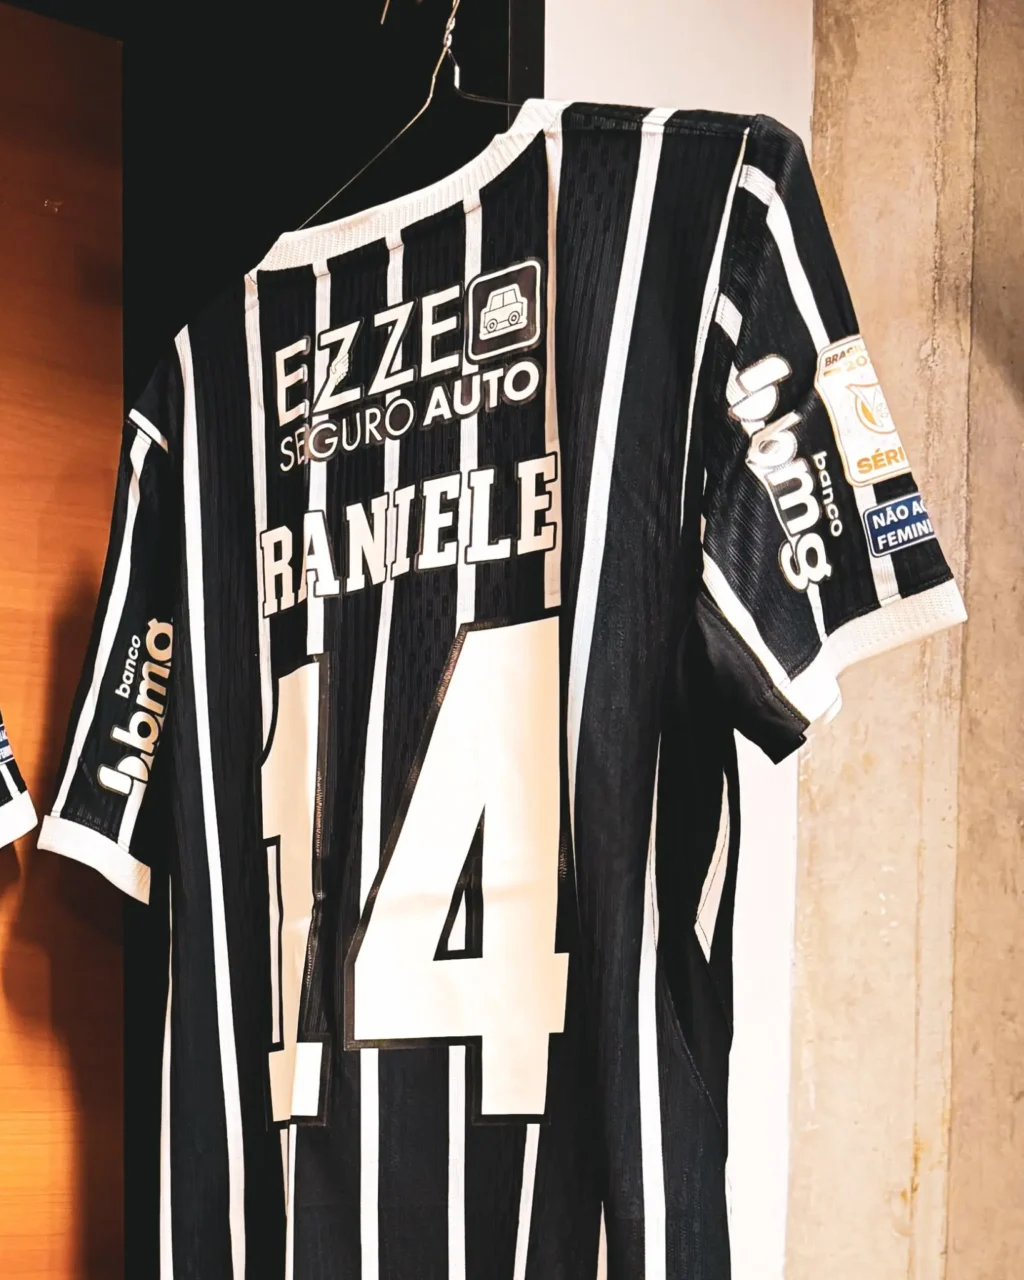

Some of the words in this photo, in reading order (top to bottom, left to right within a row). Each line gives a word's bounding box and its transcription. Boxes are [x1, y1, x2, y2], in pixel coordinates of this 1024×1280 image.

[274, 284, 462, 427] EZZE
[279, 398, 415, 472] SEGURO
[422, 360, 540, 427] AUTO
[260, 454, 558, 618] RANIELE
[813, 450, 843, 537] banco
[872, 504, 909, 530] NÃO
[114, 634, 141, 699] banco
[260, 615, 571, 1123] 14
